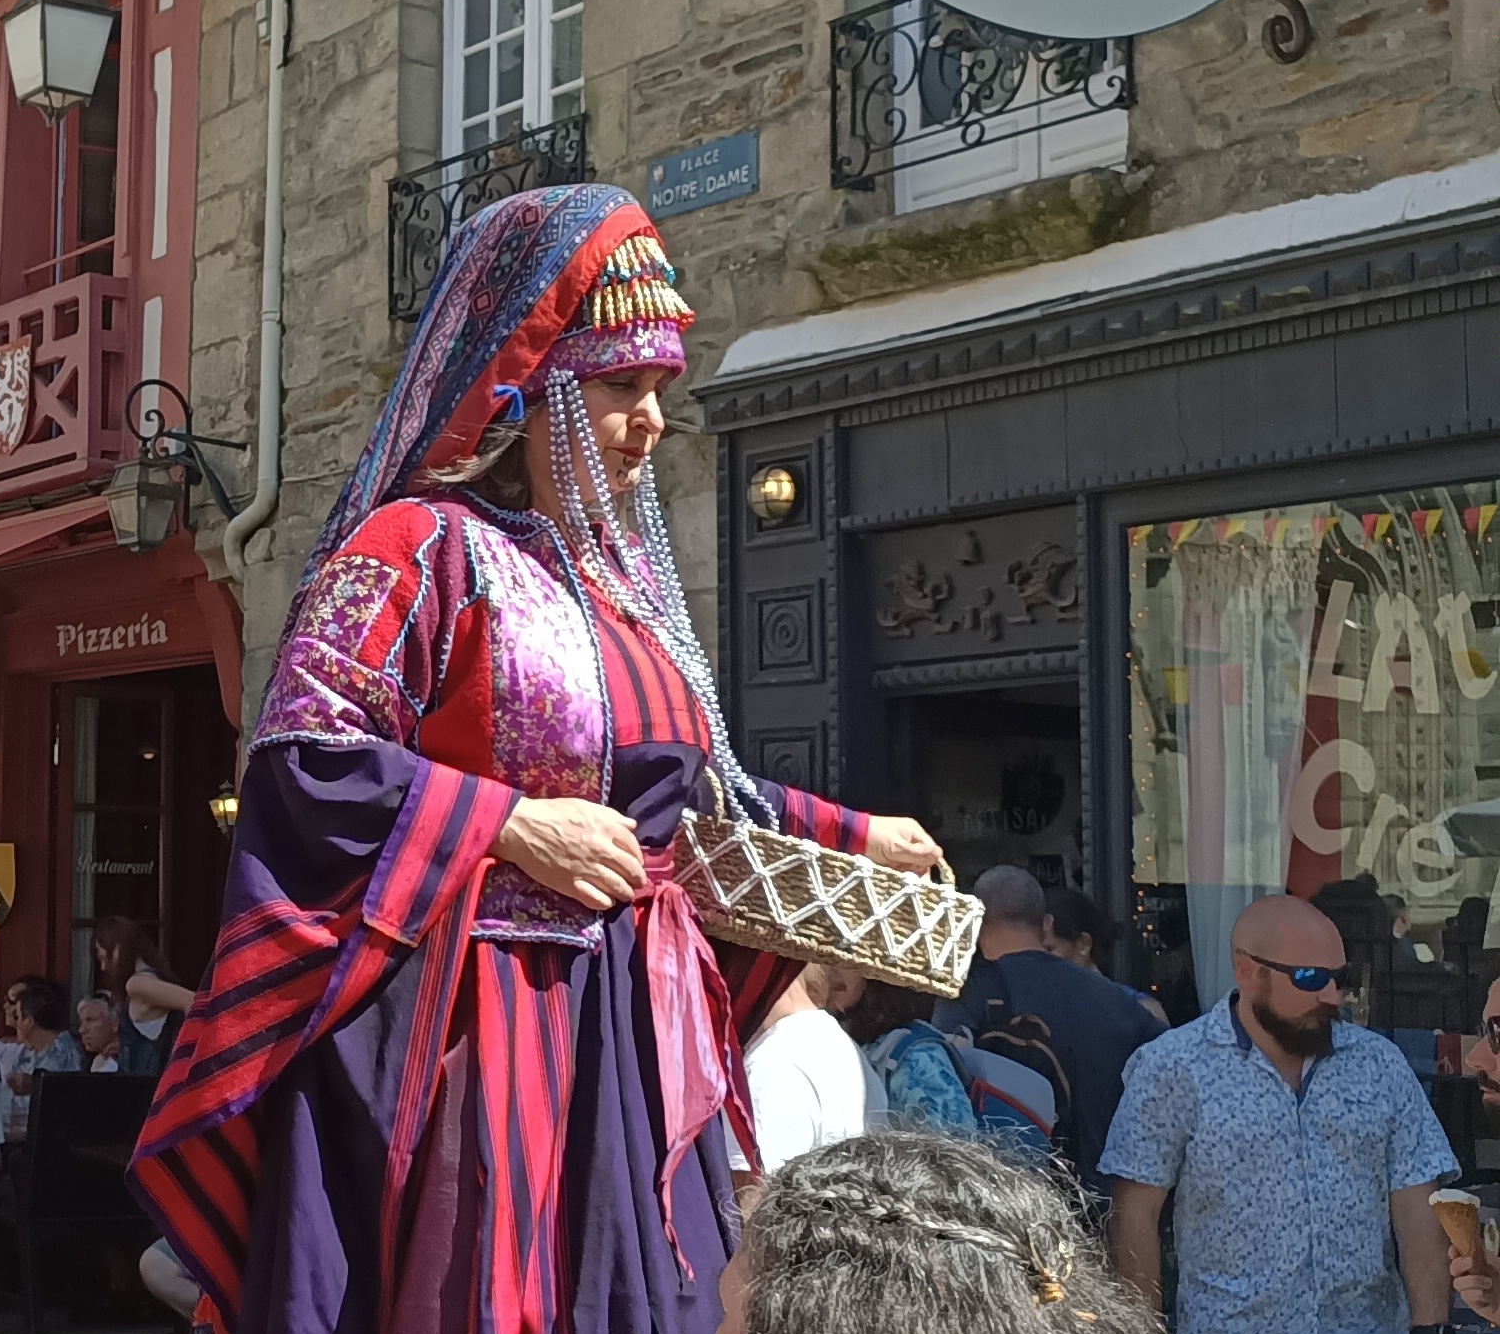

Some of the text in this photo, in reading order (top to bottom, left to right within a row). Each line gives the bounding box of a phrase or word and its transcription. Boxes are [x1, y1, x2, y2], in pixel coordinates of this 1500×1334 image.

[679, 148, 720, 173] PLACE
[55, 611, 169, 657] Pizzeria
[75, 852, 155, 875] Restaurant
